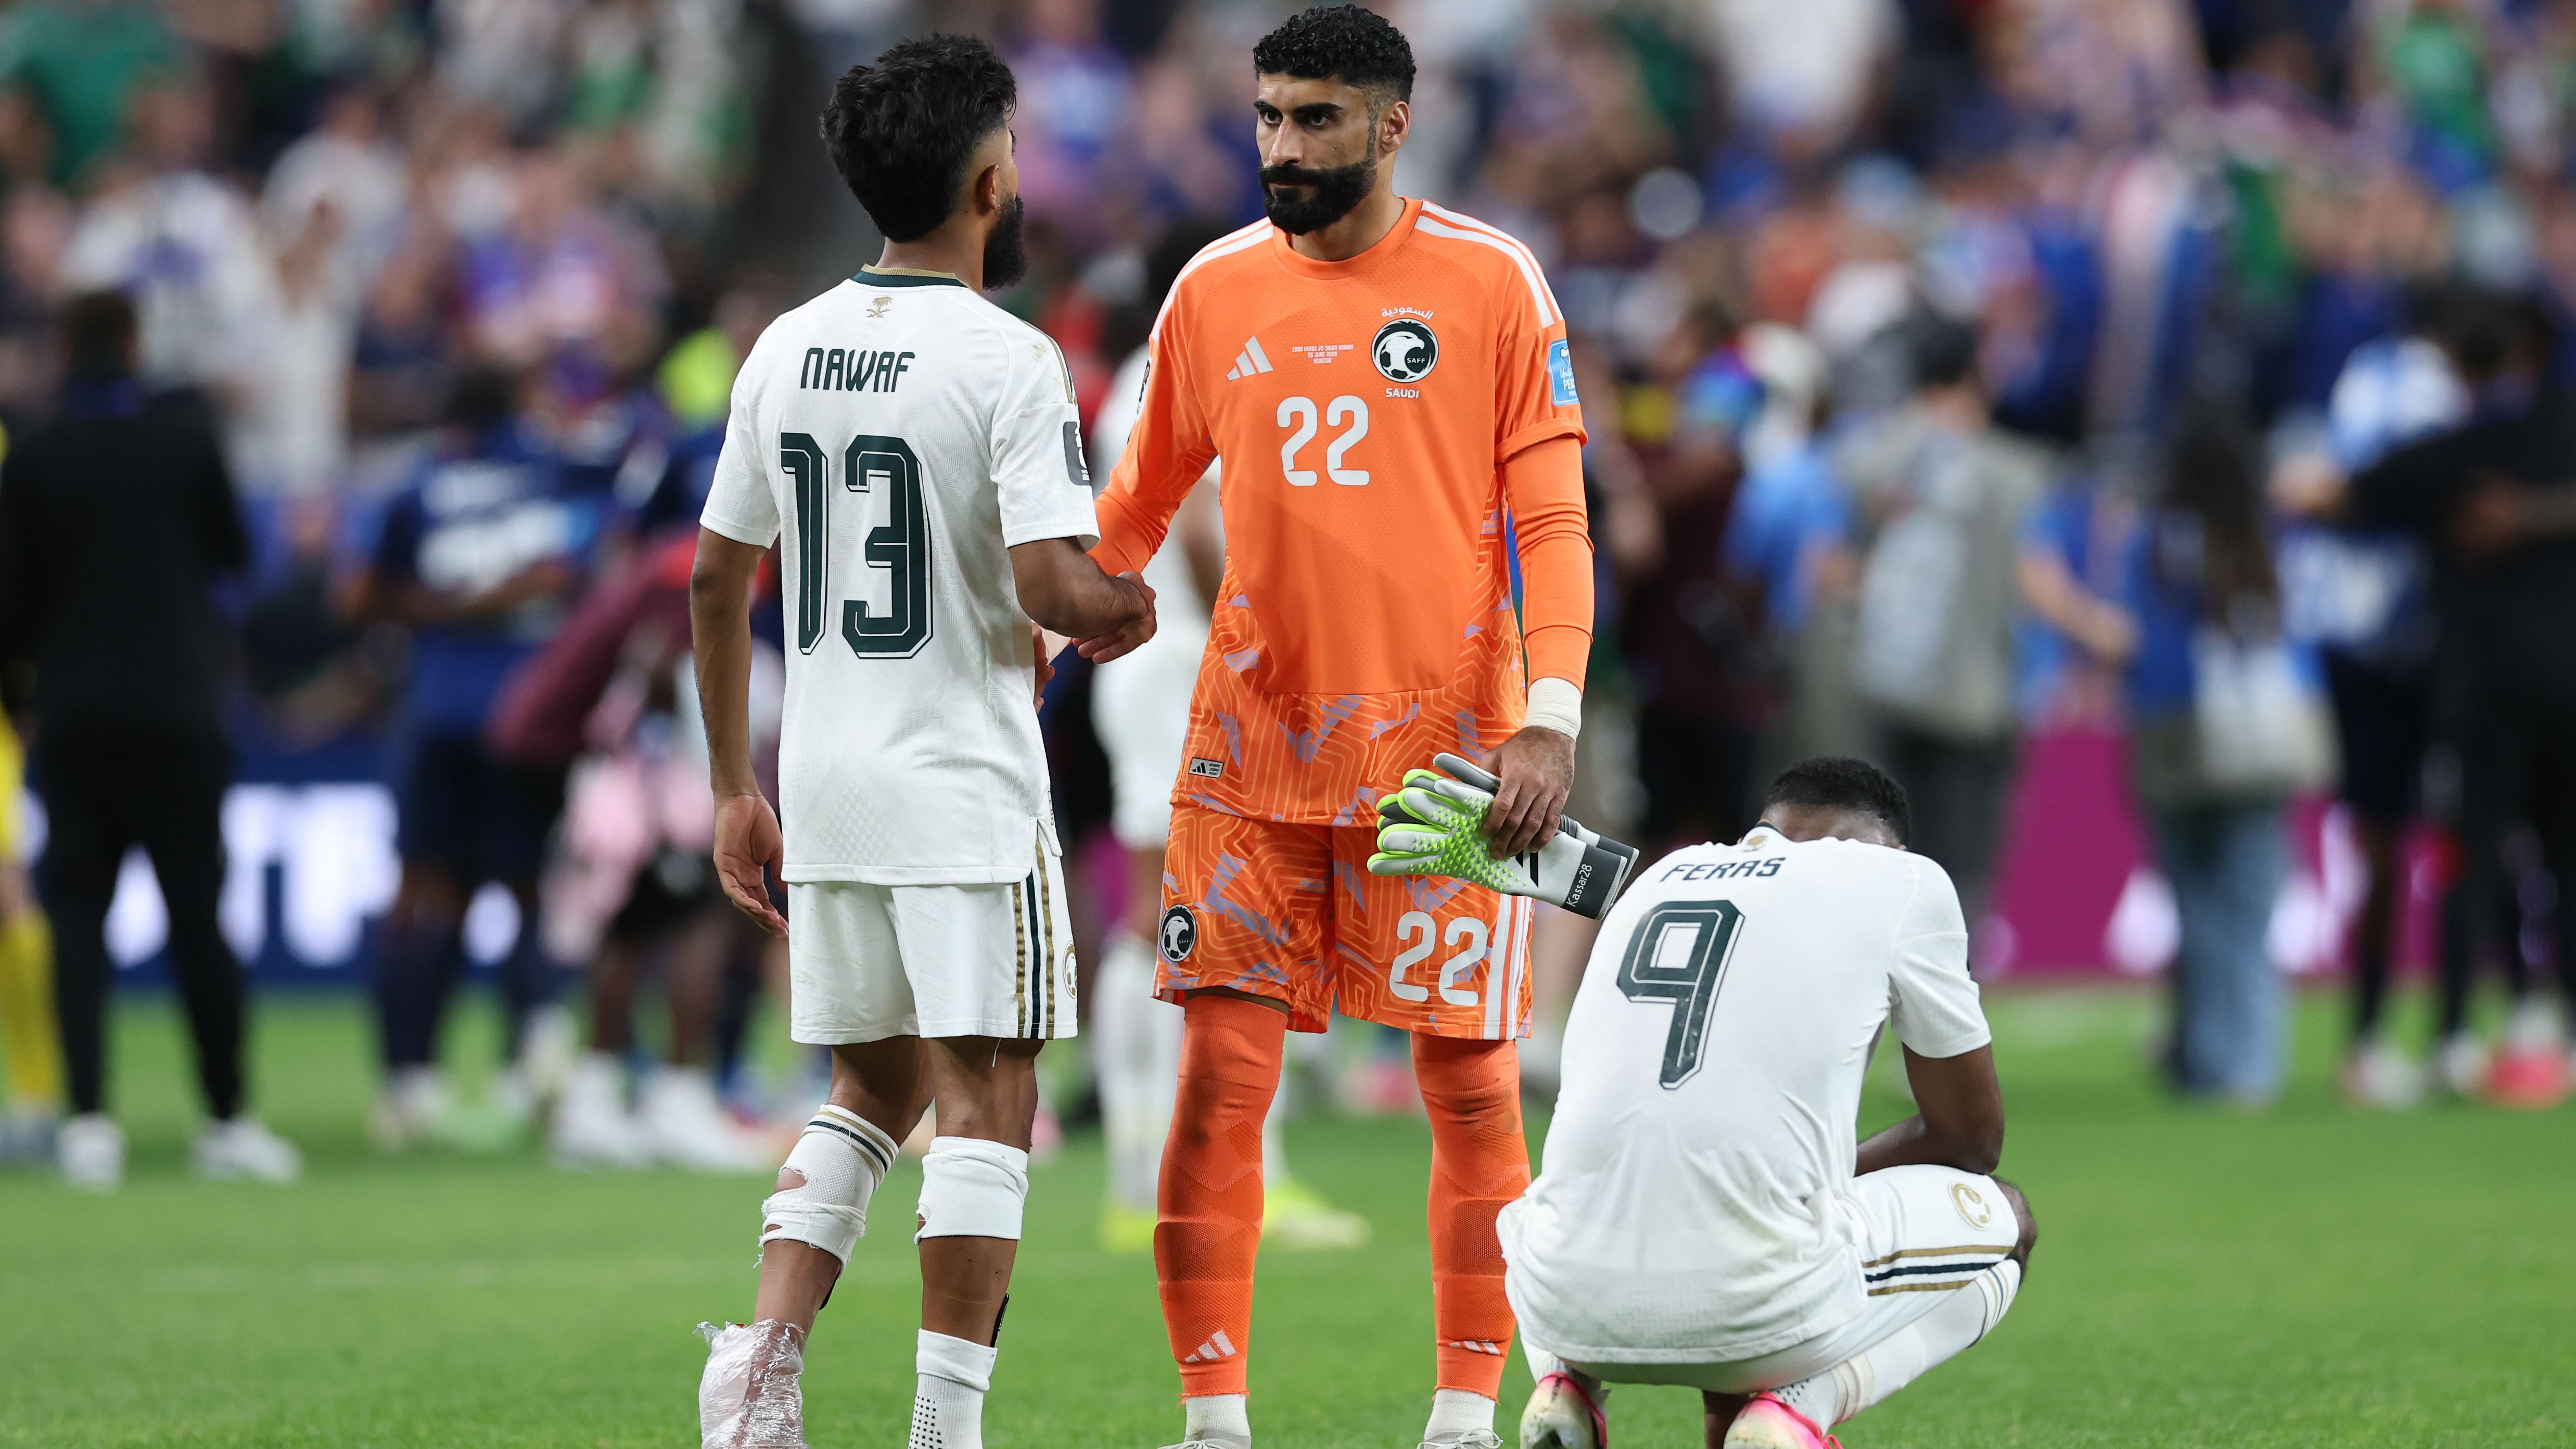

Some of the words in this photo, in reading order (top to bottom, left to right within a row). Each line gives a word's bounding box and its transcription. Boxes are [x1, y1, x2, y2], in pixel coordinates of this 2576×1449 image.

[1382, 307, 1434, 320] السعودية
[800, 347, 915, 392] NAWAF
[1385, 388, 1419, 399] SAUDI
[1277, 395, 1370, 486] 22
[781, 433, 934, 659] 13
[1566, 864, 1592, 907] Kassar28
[1659, 857, 1786, 882] FERAS
[1389, 911, 1488, 1007] 22
[1616, 900, 1745, 1090] 9
